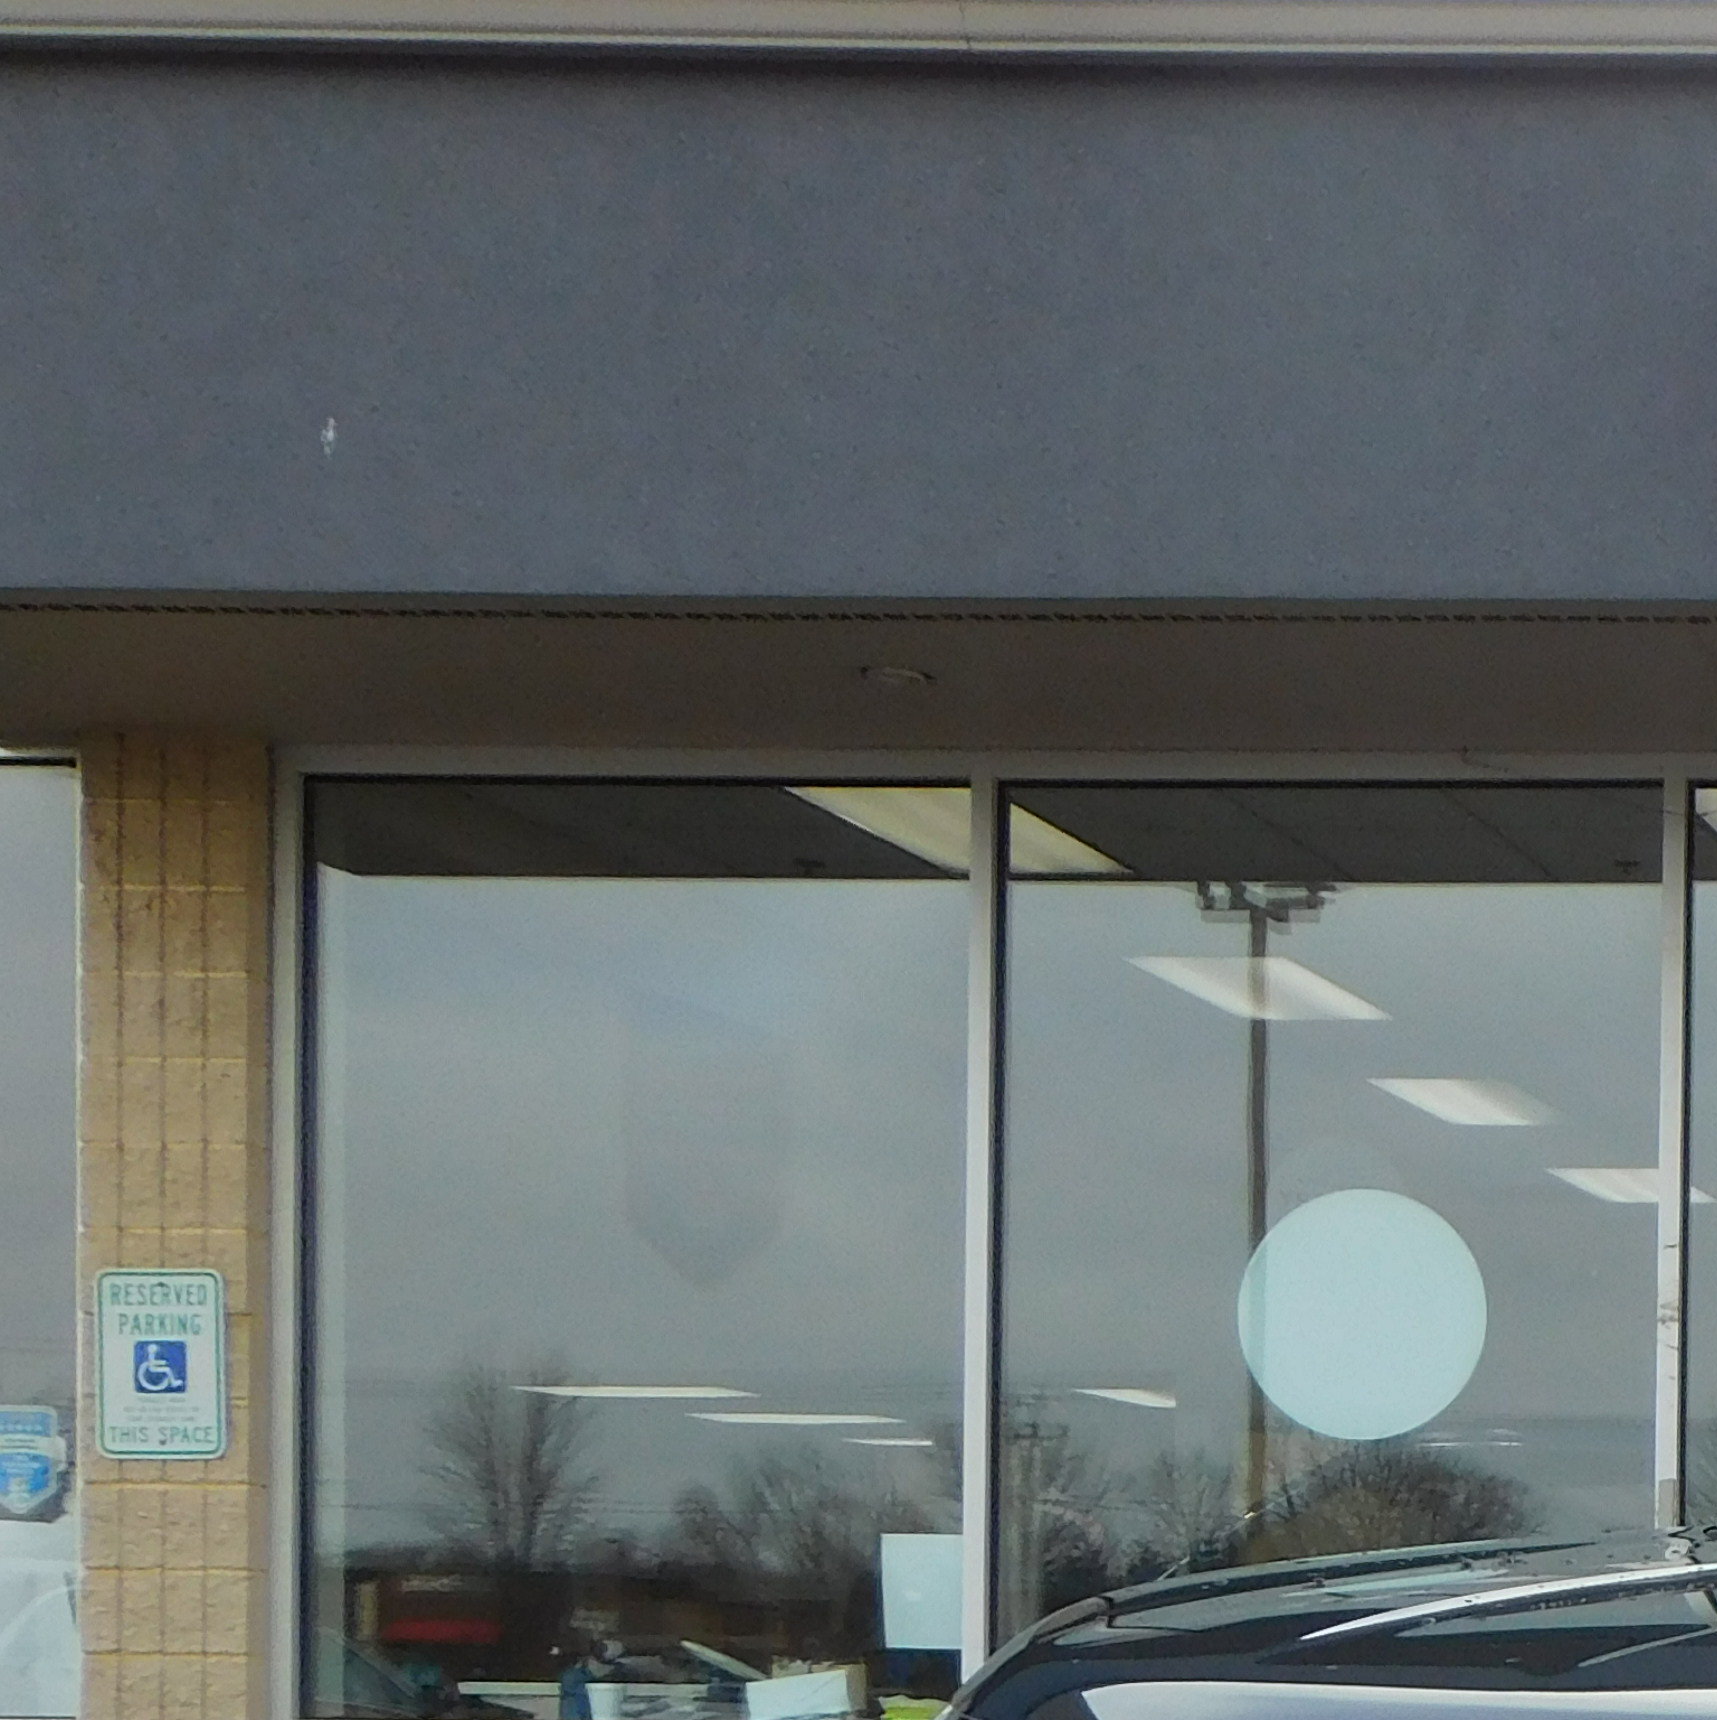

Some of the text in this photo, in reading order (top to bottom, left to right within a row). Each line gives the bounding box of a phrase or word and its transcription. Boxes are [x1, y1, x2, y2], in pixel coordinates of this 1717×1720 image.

[109, 1283, 208, 1306] RESERVED
[118, 1313, 204, 1336] PARKING
[109, 1425, 216, 1444] THIS SPACE
